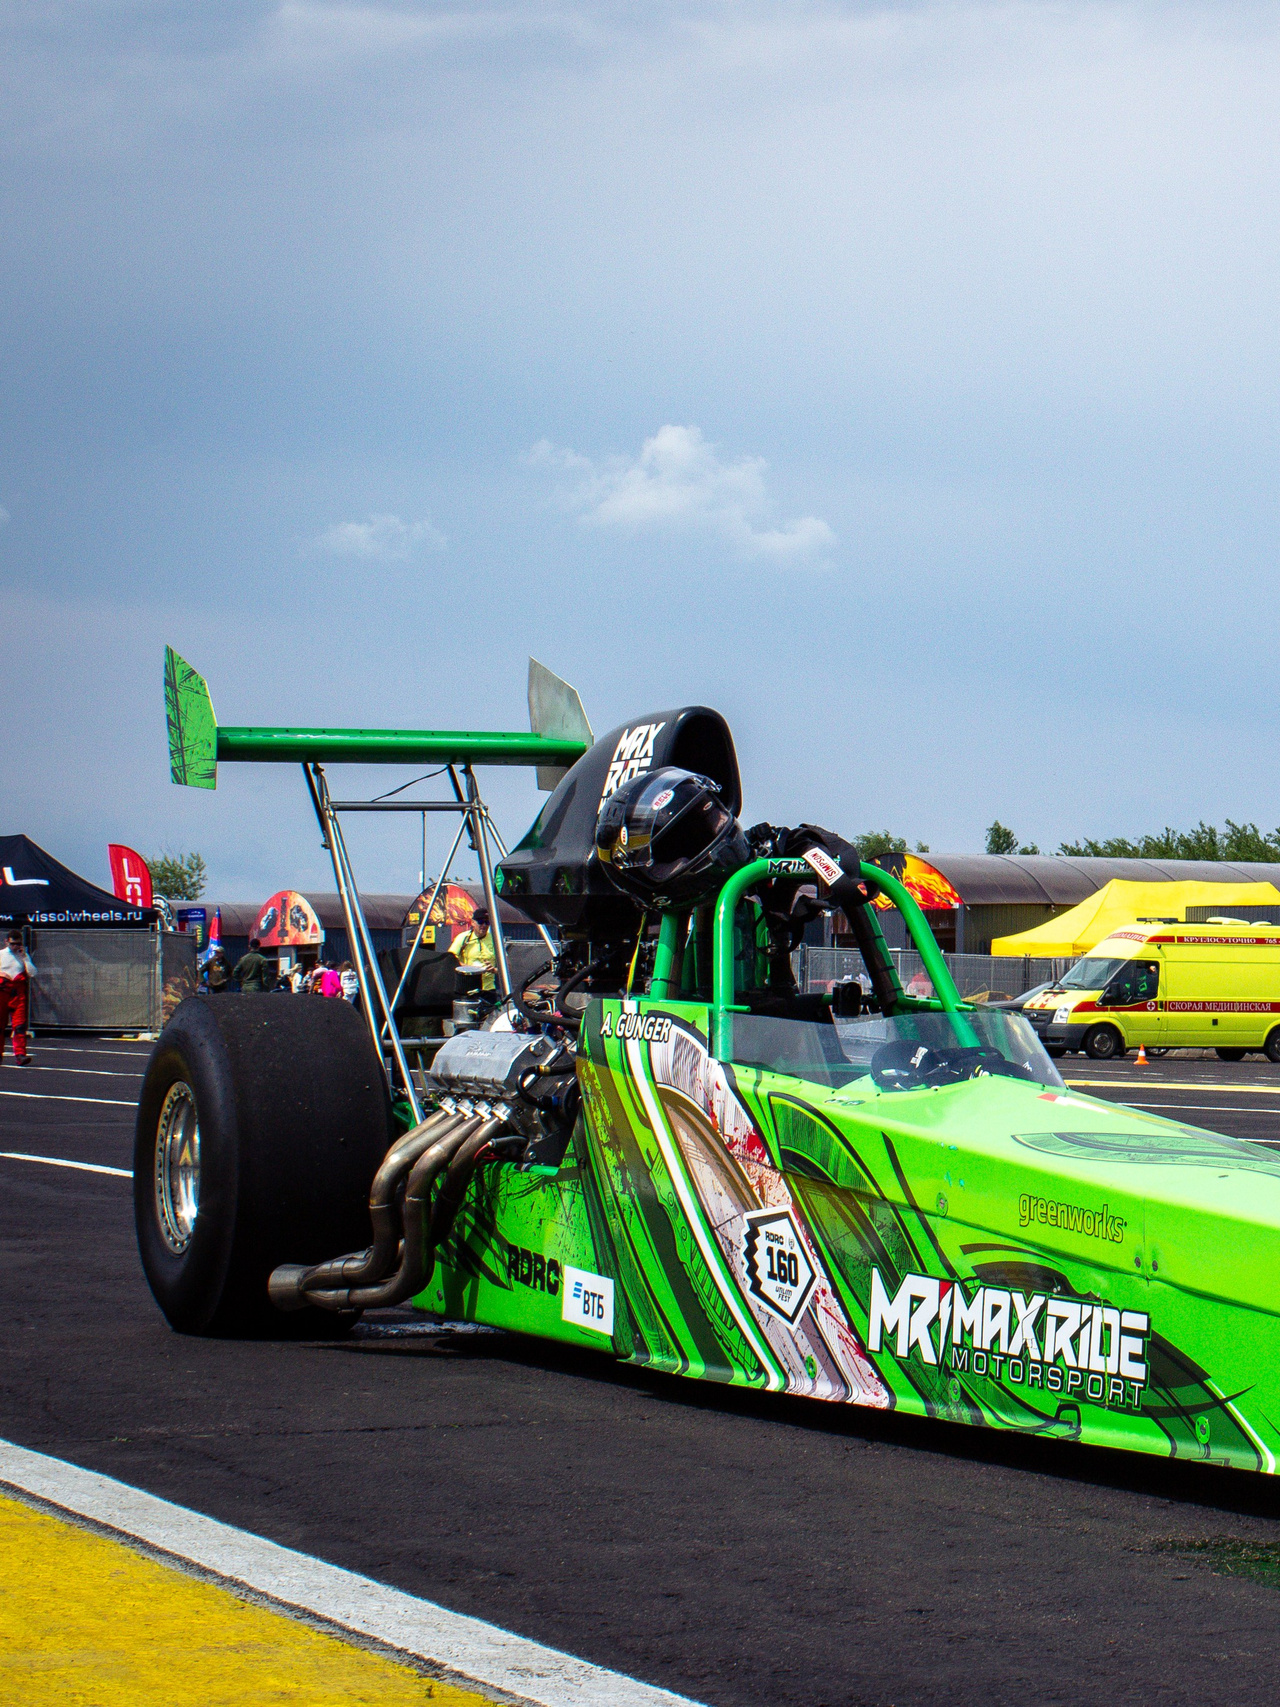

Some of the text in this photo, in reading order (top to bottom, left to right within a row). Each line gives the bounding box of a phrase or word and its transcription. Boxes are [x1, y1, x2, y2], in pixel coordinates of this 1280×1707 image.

[612, 722, 666, 762] MAX
[811, 851, 837, 878] SIMPSON
[27, 909, 143, 922] vissolwheels.ru
[1183, 936, 1257, 944] КРУГЛОСУТОЧНО
[1169, 1002, 1203, 1011] СКОРАЯ
[1205, 1002, 1271, 1012] МЕДИЦИНСКАЯ
[615, 1013, 672, 1042] GUNGER
[1019, 1193, 1124, 1244] greenworks
[765, 1231, 784, 1246] RDRC
[508, 1243, 560, 1297] RDRC
[766, 1245, 799, 1288] 160
[583, 1290, 605, 1320] ВТБ
[778, 1294, 791, 1303] FEST
[952, 1348, 1144, 1407] MOTORSPORT
